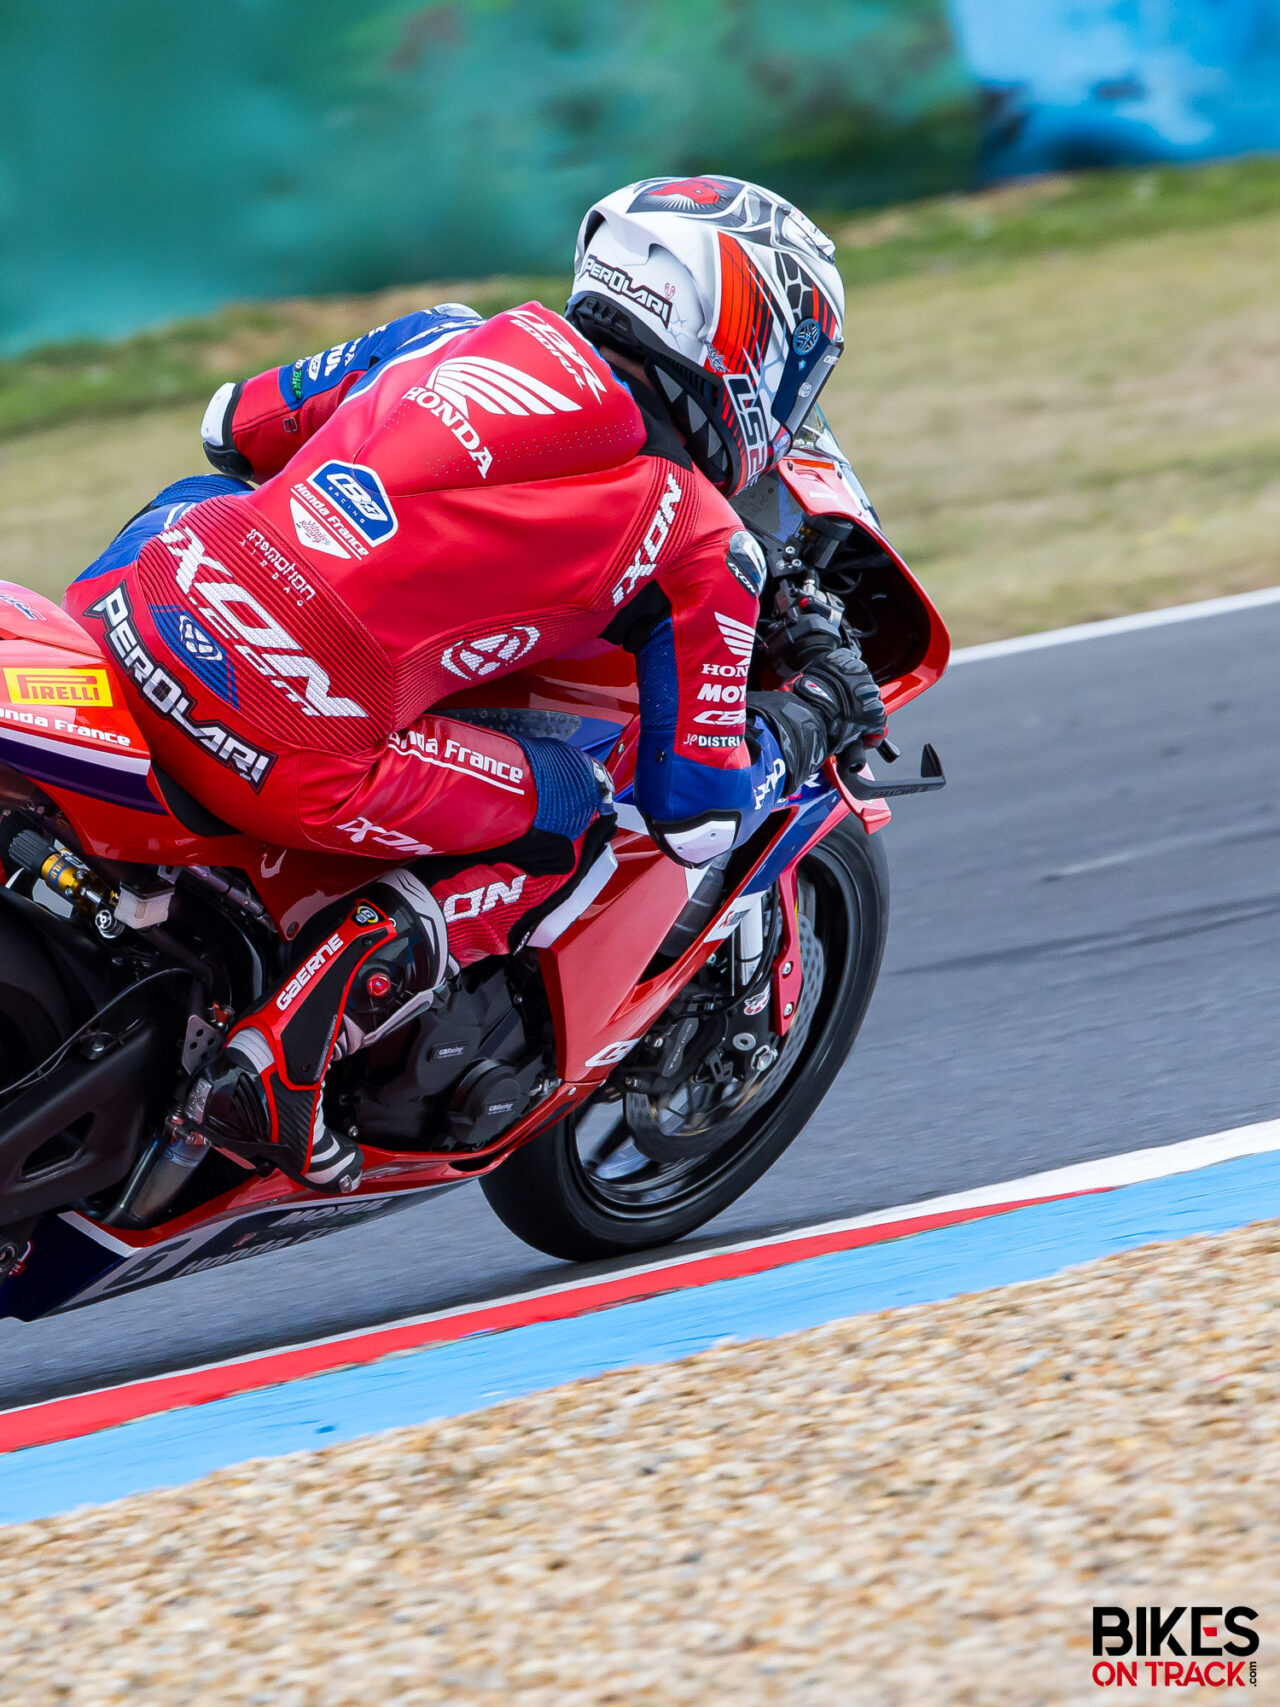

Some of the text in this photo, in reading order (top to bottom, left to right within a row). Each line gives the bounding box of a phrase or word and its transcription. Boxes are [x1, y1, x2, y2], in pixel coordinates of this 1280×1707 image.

[401, 387, 494, 478] HONDA
[293, 483, 370, 556] Honda France
[328, 485, 365, 524] RACING
[612, 473, 682, 607] IXON
[728, 562, 756, 593] IXON
[156, 526, 371, 718] IXON
[20, 674, 99, 701] PIRELLI
[85, 581, 270, 788] PEROLARI
[701, 663, 750, 677] HON
[697, 683, 746, 704] MOT
[54, 718, 131, 747] France
[388, 730, 524, 784] onda France
[336, 816, 446, 856] IXON
[267, 1198, 393, 1228] MOTUL
